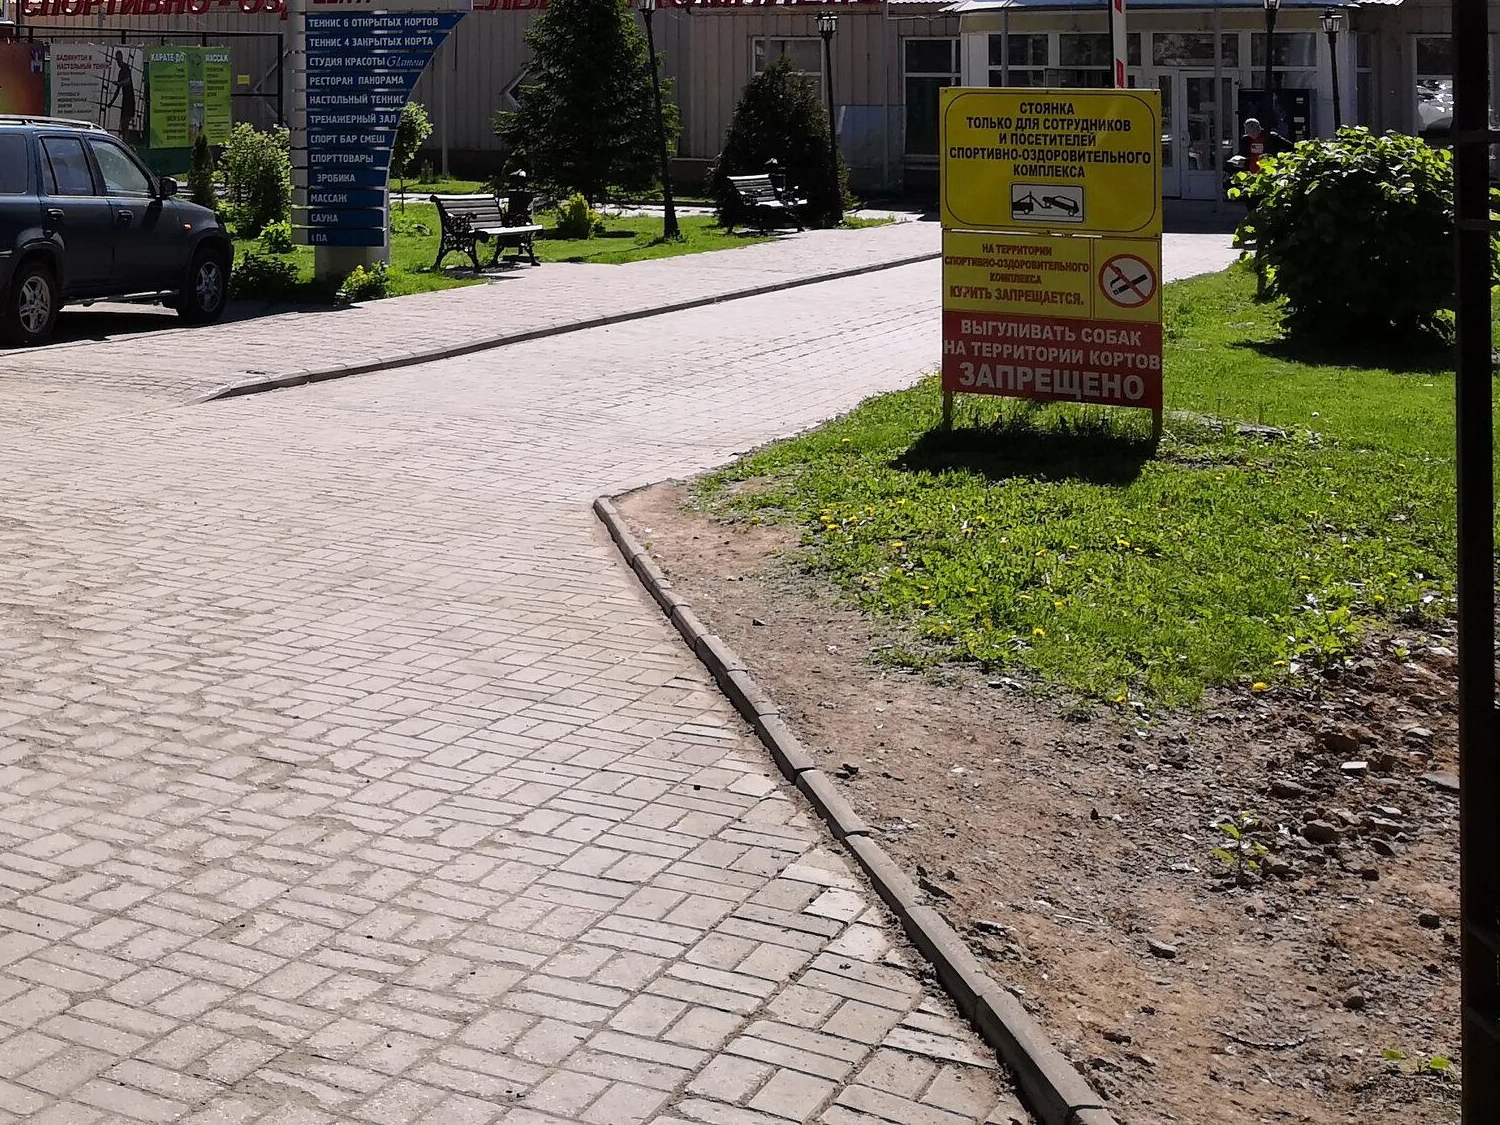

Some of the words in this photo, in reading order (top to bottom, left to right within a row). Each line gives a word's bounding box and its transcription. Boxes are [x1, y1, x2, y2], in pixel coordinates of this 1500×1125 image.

[308, 18, 341, 28] ТЕННИС
[351, 17, 402, 27] ОТКРЫТЫХ
[404, 17, 439, 26] КОРТОВ
[309, 38, 342, 47] ТЕННИС
[344, 38, 350, 46] 4
[352, 37, 402, 47] ЗАКРЫТЫХ
[404, 37, 434, 46] КОРТА
[309, 57, 342, 67] СТУДИЯ
[344, 56, 386, 66] КРАСОТЫ
[309, 76, 353, 85] РЕСТОРАН
[358, 75, 404, 85] ПАНОРАМА
[309, 93, 368, 104] НАСТОЛЬНЫЙ
[370, 94, 405, 104] ТЕННИС
[1019, 101, 1075, 115] СТОЯНКА
[310, 113, 376, 124] ТРЕНАЖЕРНЫЙ
[379, 114, 397, 124] ЗАЛ
[966, 116, 1012, 130] ТОЛЬКО
[1015, 117, 1040, 132] ДЛЯ
[1043, 118, 1132, 133] СОТРУДНИКОВ
[310, 134, 337, 144] СПОРТ
[340, 134, 358, 144] БАР
[360, 134, 386, 144] СМЕШ
[999, 133, 1008, 145] И
[1010, 132, 1097, 147] ПОСЕТИТЕЛЕЙ
[310, 153, 374, 163] СПОРТТОВАРЫ
[950, 146, 1152, 165] СПОРТИВНО-ОЗДОРОВИТЕЛЬНОГО
[1013, 163, 1086, 179] КОМПЛЕКСА
[310, 193, 348, 203] МАССАЖ
[310, 213, 339, 223] САУНА
[982, 243, 995, 254] НА
[996, 244, 1053, 256] ТЕРРИТОРИИ
[989, 272, 1043, 285] КОМПЛЕКСА
[950, 285, 993, 300] КУРИТЬ
[960, 319, 1077, 342] ВЫГУЛИВАТЬ
[1080, 327, 1143, 347] СОБАК
[943, 339, 967, 356] НА
[971, 341, 1085, 365] ТЕРРИТОРИИ
[1089, 349, 1161, 371] КОРТОВ
[958, 362, 1146, 401] ЗАПРЕЩЕНО
